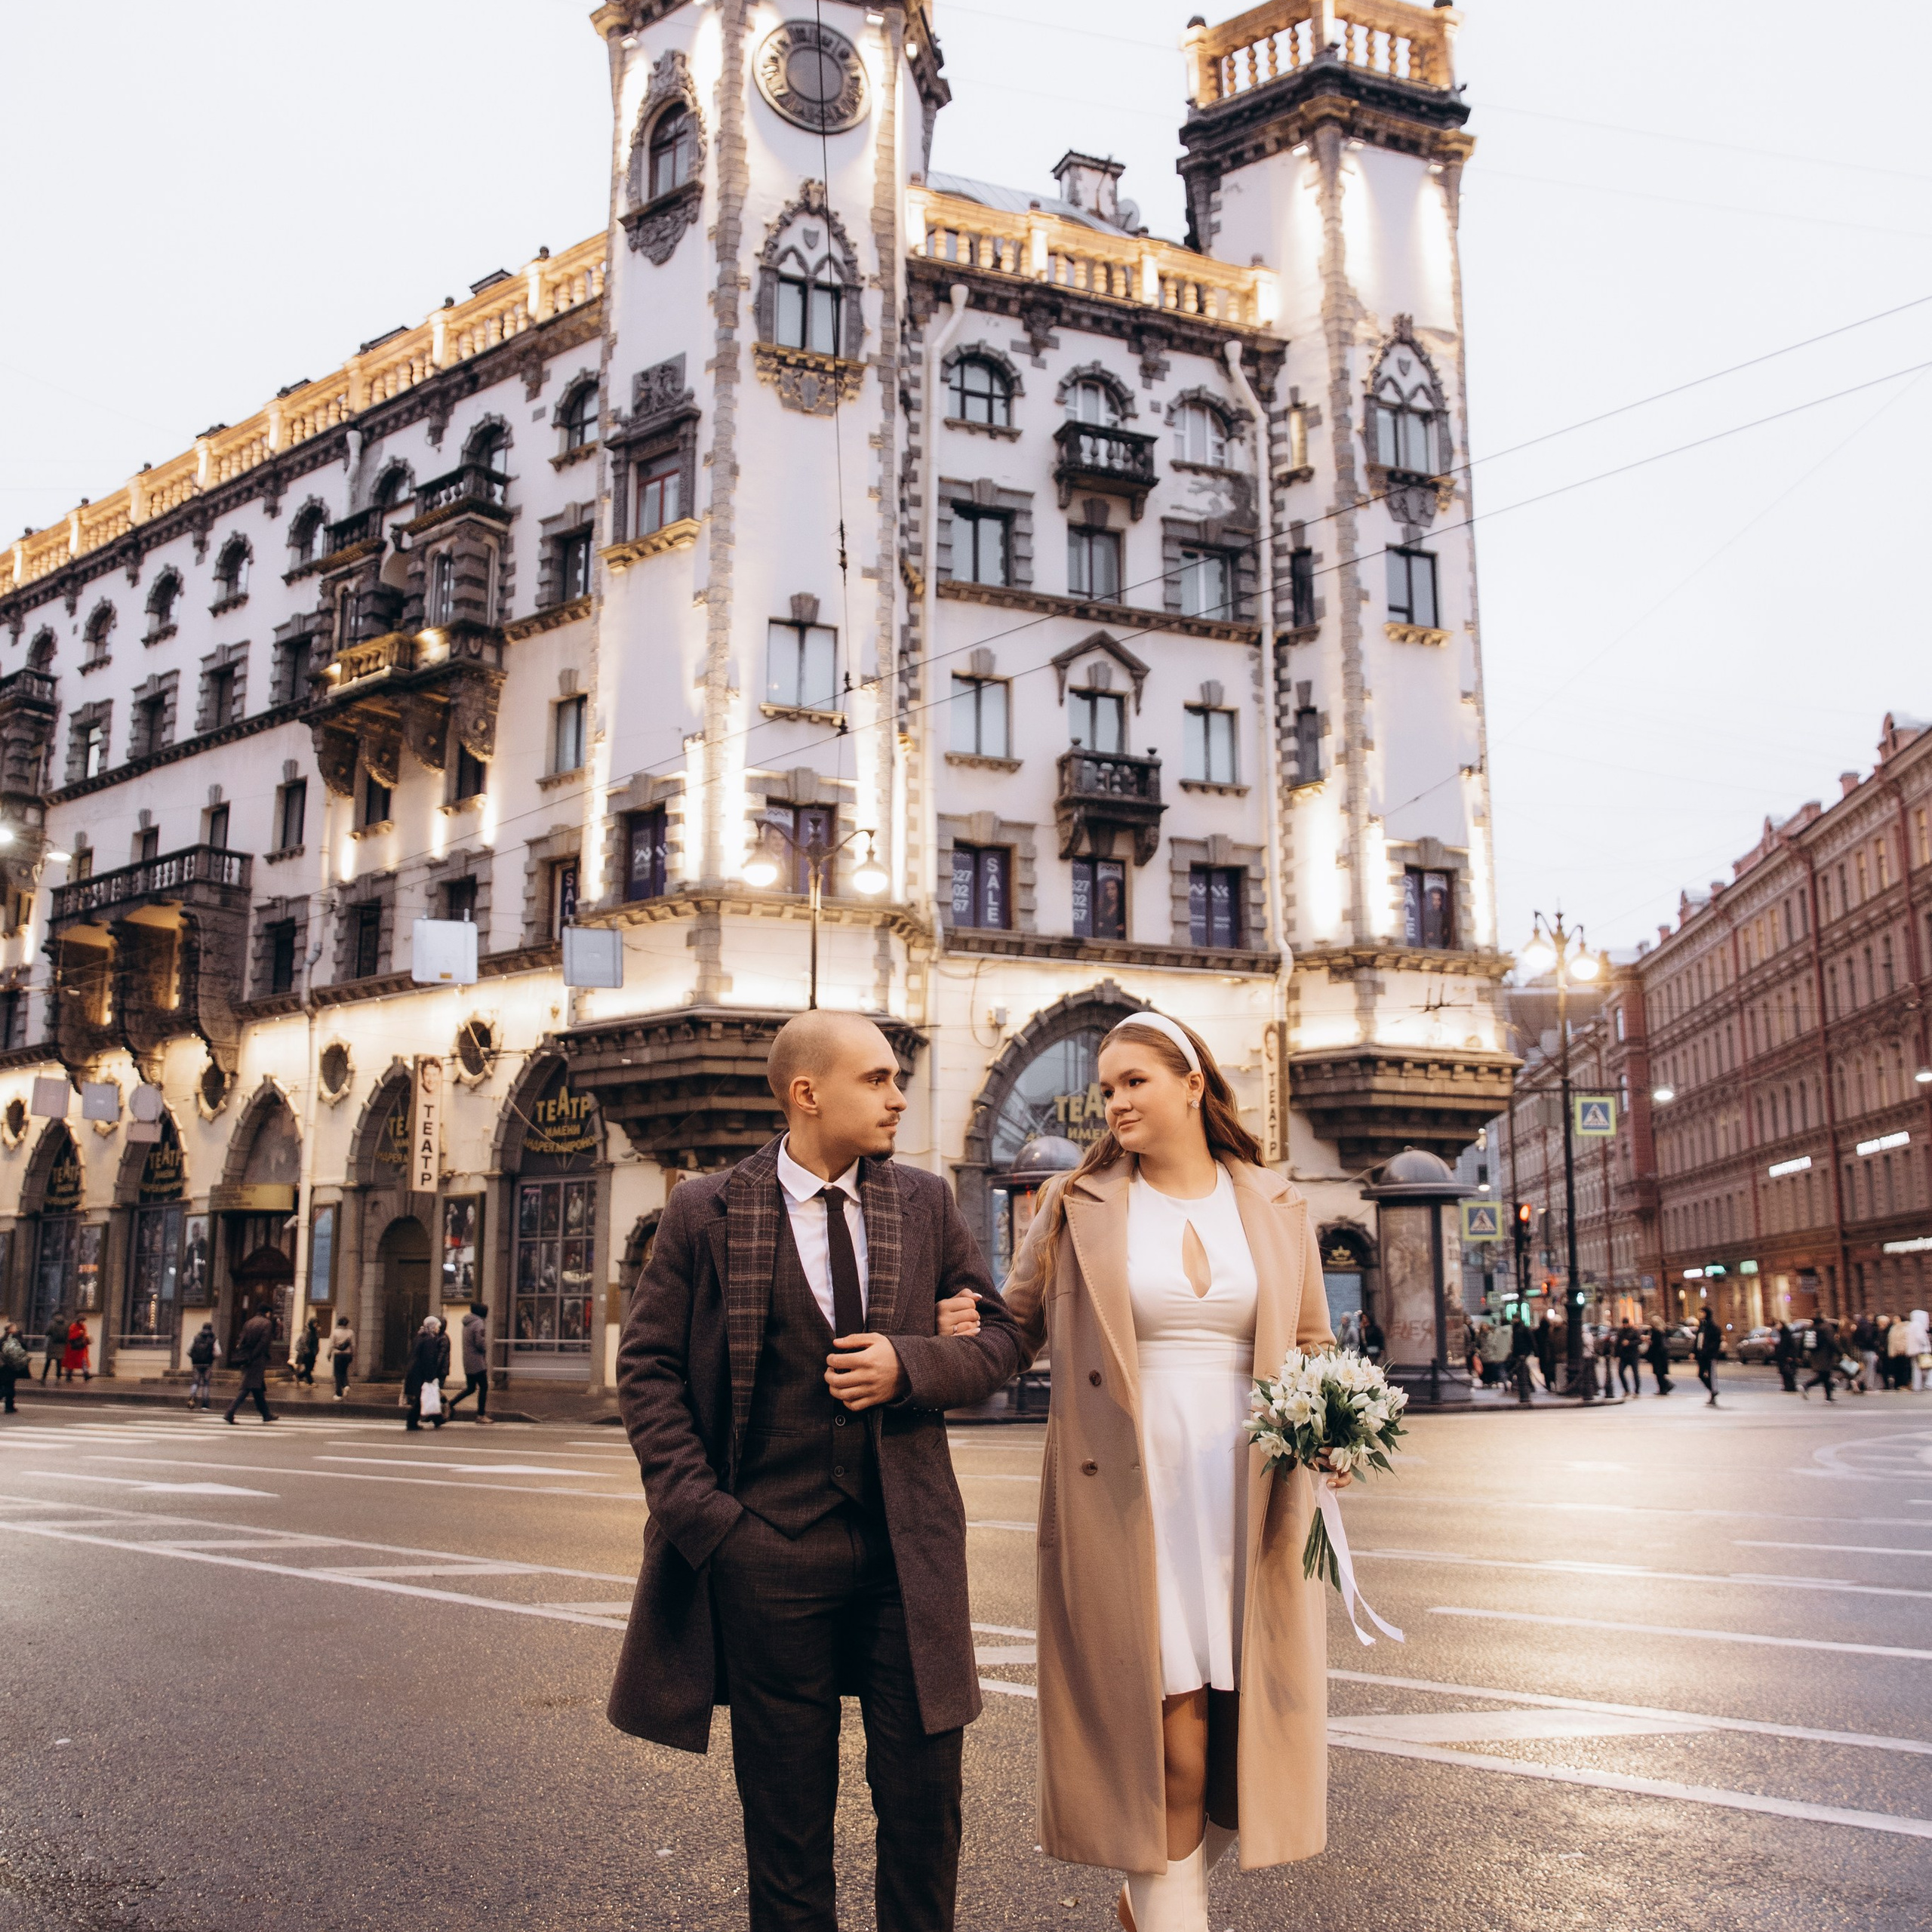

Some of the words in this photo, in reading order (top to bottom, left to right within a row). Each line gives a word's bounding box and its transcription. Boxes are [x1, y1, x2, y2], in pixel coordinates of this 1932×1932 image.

[986, 857, 1000, 923] SALE
[1404, 875, 1416, 938] SALE
[537, 1085, 592, 1122] ТЕАТР
[1054, 1082, 1105, 1122] ТЕА
[1269, 1072, 1277, 1155] ТЕАТР
[421, 1104, 435, 1186] ТЕАТР
